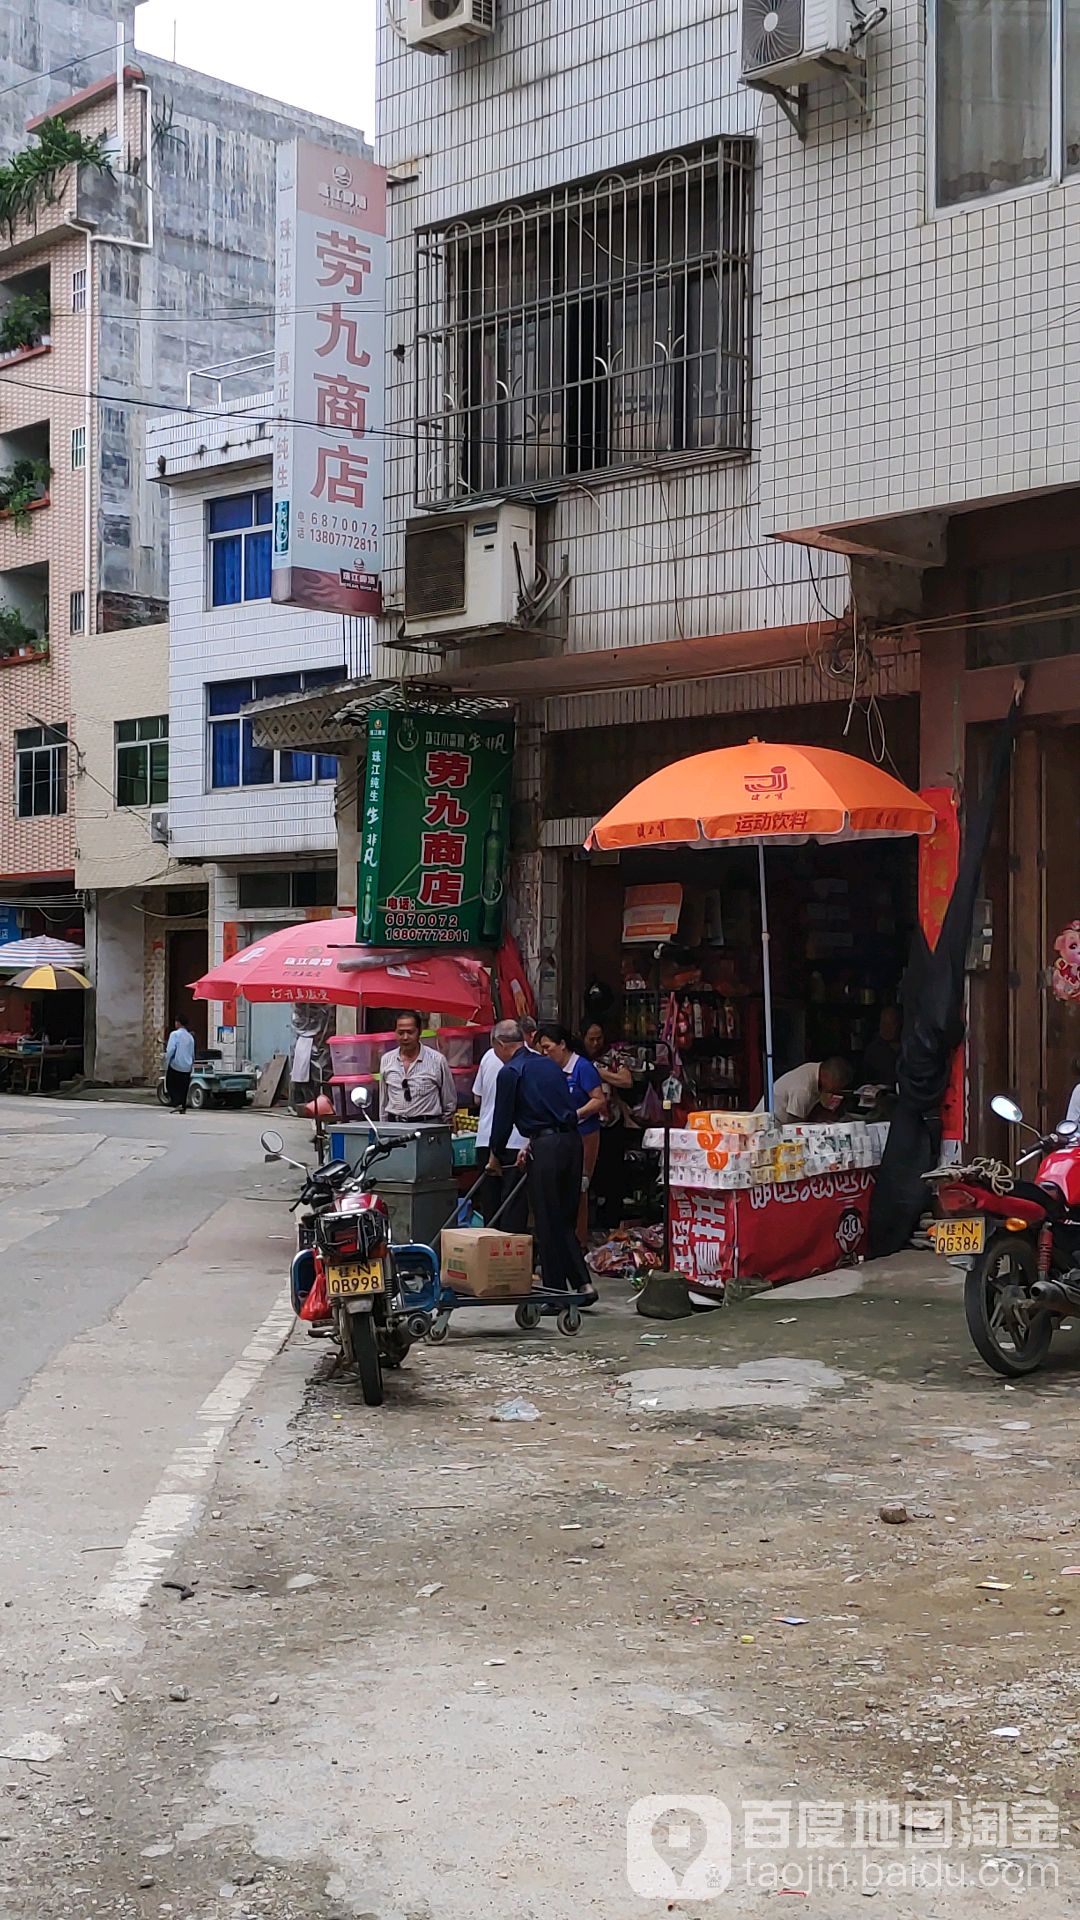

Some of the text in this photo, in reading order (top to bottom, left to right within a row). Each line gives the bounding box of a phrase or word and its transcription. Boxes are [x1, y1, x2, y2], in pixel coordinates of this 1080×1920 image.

[310, 230, 371, 509] 劳九商店
[311, 512, 378, 537] 6870072
[310, 529, 378, 553] 13807772811
[369, 750, 382, 802] 珠江纯生
[417, 750, 471, 906] 劳九商店
[735, 811, 808, 834] 运动饮料
[385, 913, 458, 927] 6870072
[385, 928, 470, 942] 13807772811
[938, 1236, 979, 1252] QG386
[331, 1275, 379, 1293] QB998
